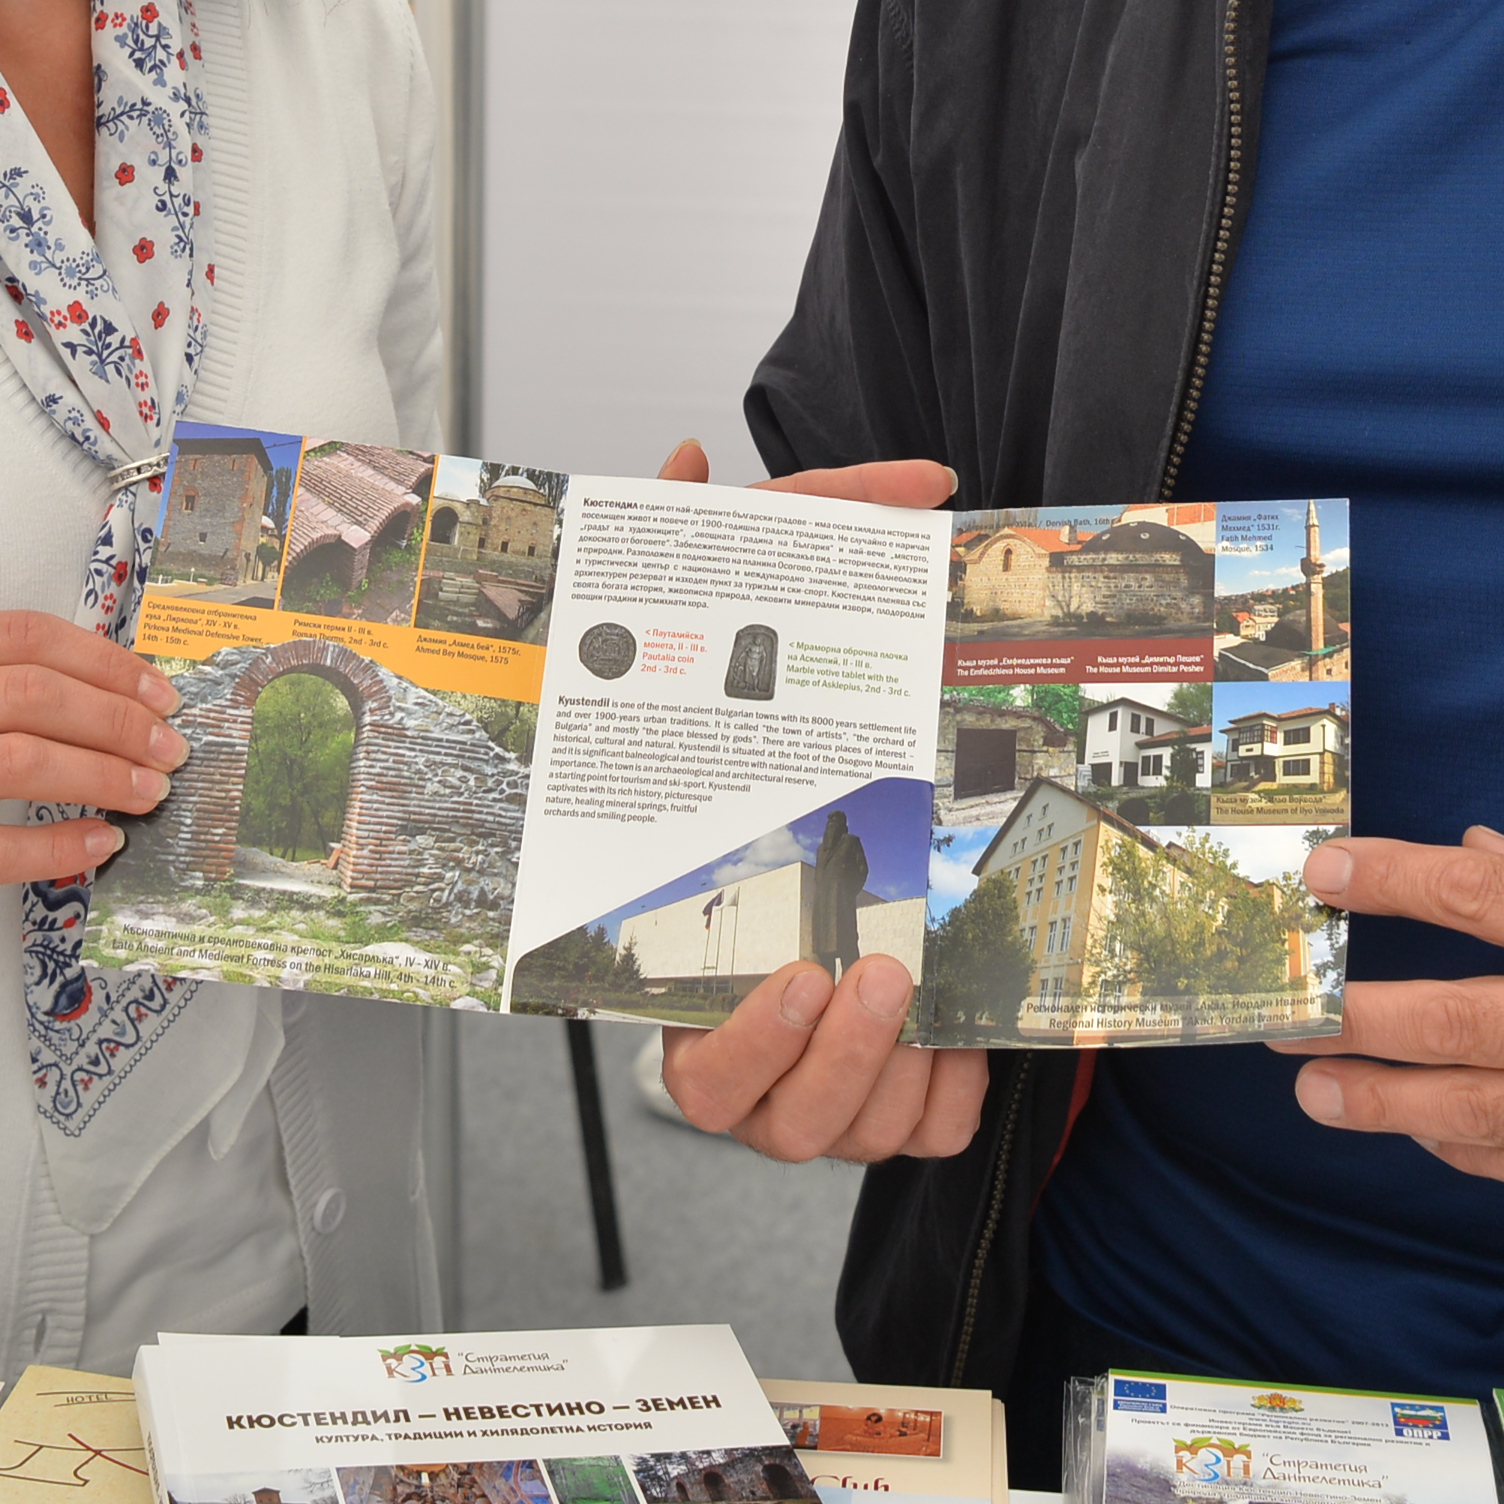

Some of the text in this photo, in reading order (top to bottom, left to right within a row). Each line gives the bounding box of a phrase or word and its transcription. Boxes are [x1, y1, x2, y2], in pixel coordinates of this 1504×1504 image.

[583, 497, 638, 510] Кюстендил
[171, 626, 203, 637] Medieval
[205, 630, 240, 641] Defensive
[652, 628, 704, 641] Пауталийска
[415, 645, 508, 665] Ahmed Bey Mosque, 1575
[796, 641, 841, 655] Мраморна
[843, 646, 878, 659] оброчна
[642, 652, 694, 664] Pautalia coin
[641, 664, 677, 674] 2nd 3rd
[787, 664, 898, 683] Marble votive tablet with the
[957, 668, 969, 676] The
[1015, 667, 1035, 675] House
[1037, 666, 1065, 674] Museum
[1086, 665, 1097, 673] The
[1099, 665, 1119, 673] House
[1122, 665, 1151, 673] Museum
[1153, 664, 1178, 673] Dimitar
[785, 676, 901, 696] image of Asklepius, 2nd 3rd
[558, 695, 609, 708] Kyustendil
[544, 808, 579, 817] orchards
[597, 811, 626, 822] smiling
[627, 814, 657, 823] people.
[1216, 806, 1228, 815] The
[1231, 806, 1254, 815] House
[1256, 806, 1288, 815] Museum
[207, 935, 288, 953] средновековна
[291, 946, 332, 958] крепост
[405, 956, 415, 967] IV
[423, 959, 439, 970] XIV
[112, 938, 134, 951] Late
[136, 941, 174, 956] Ancient
[176, 947, 195, 958] and
[198, 948, 244, 963] Medieval
[246, 954, 287, 969] Fortress
[289, 960, 302, 971] on
[305, 962, 321, 973] the
[397, 973, 414, 984] 4th
[424, 975, 446, 988] 14th
[1049, 1018, 1094, 1030] Regional
[1096, 1018, 1133, 1031] History
[1136, 1017, 1179, 1028] Museum
[66, 1393, 112, 1404] HOTEL
[226, 1409, 411, 1430] КЮСТЕНДИЛ
[442, 1400, 605, 1421] НЕВЕСТИНО
[635, 1395, 722, 1413] ЗЕМЕН
[315, 1421, 653, 1444] КУЛТУРА, ТРАДИЦИИ И ХИЛЯДОЛЕТНА ИСТОРИЯ
[1403, 1428, 1441, 1439] ОПРР
